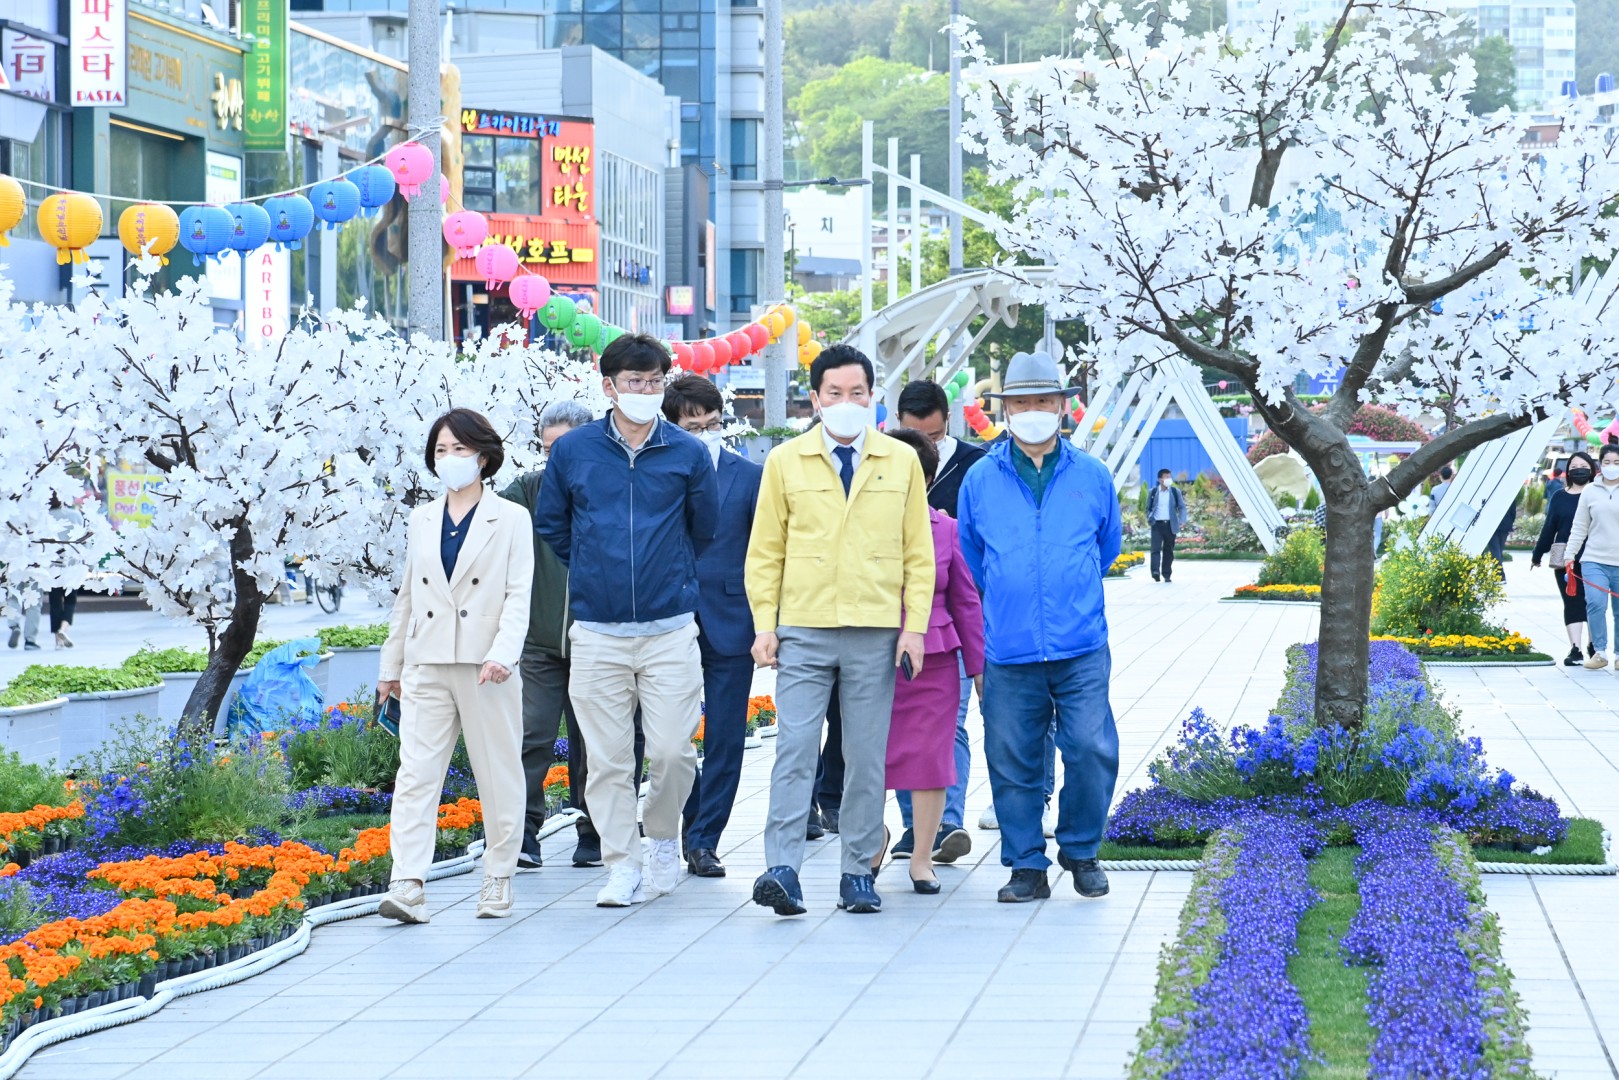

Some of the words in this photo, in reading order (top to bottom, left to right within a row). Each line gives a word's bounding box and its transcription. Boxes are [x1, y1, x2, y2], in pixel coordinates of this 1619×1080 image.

[76, 90, 123, 102] PASTA
[478, 112, 561, 138] 스카이라운지
[554, 145, 591, 175] 만선
[553, 181, 590, 212] 타운
